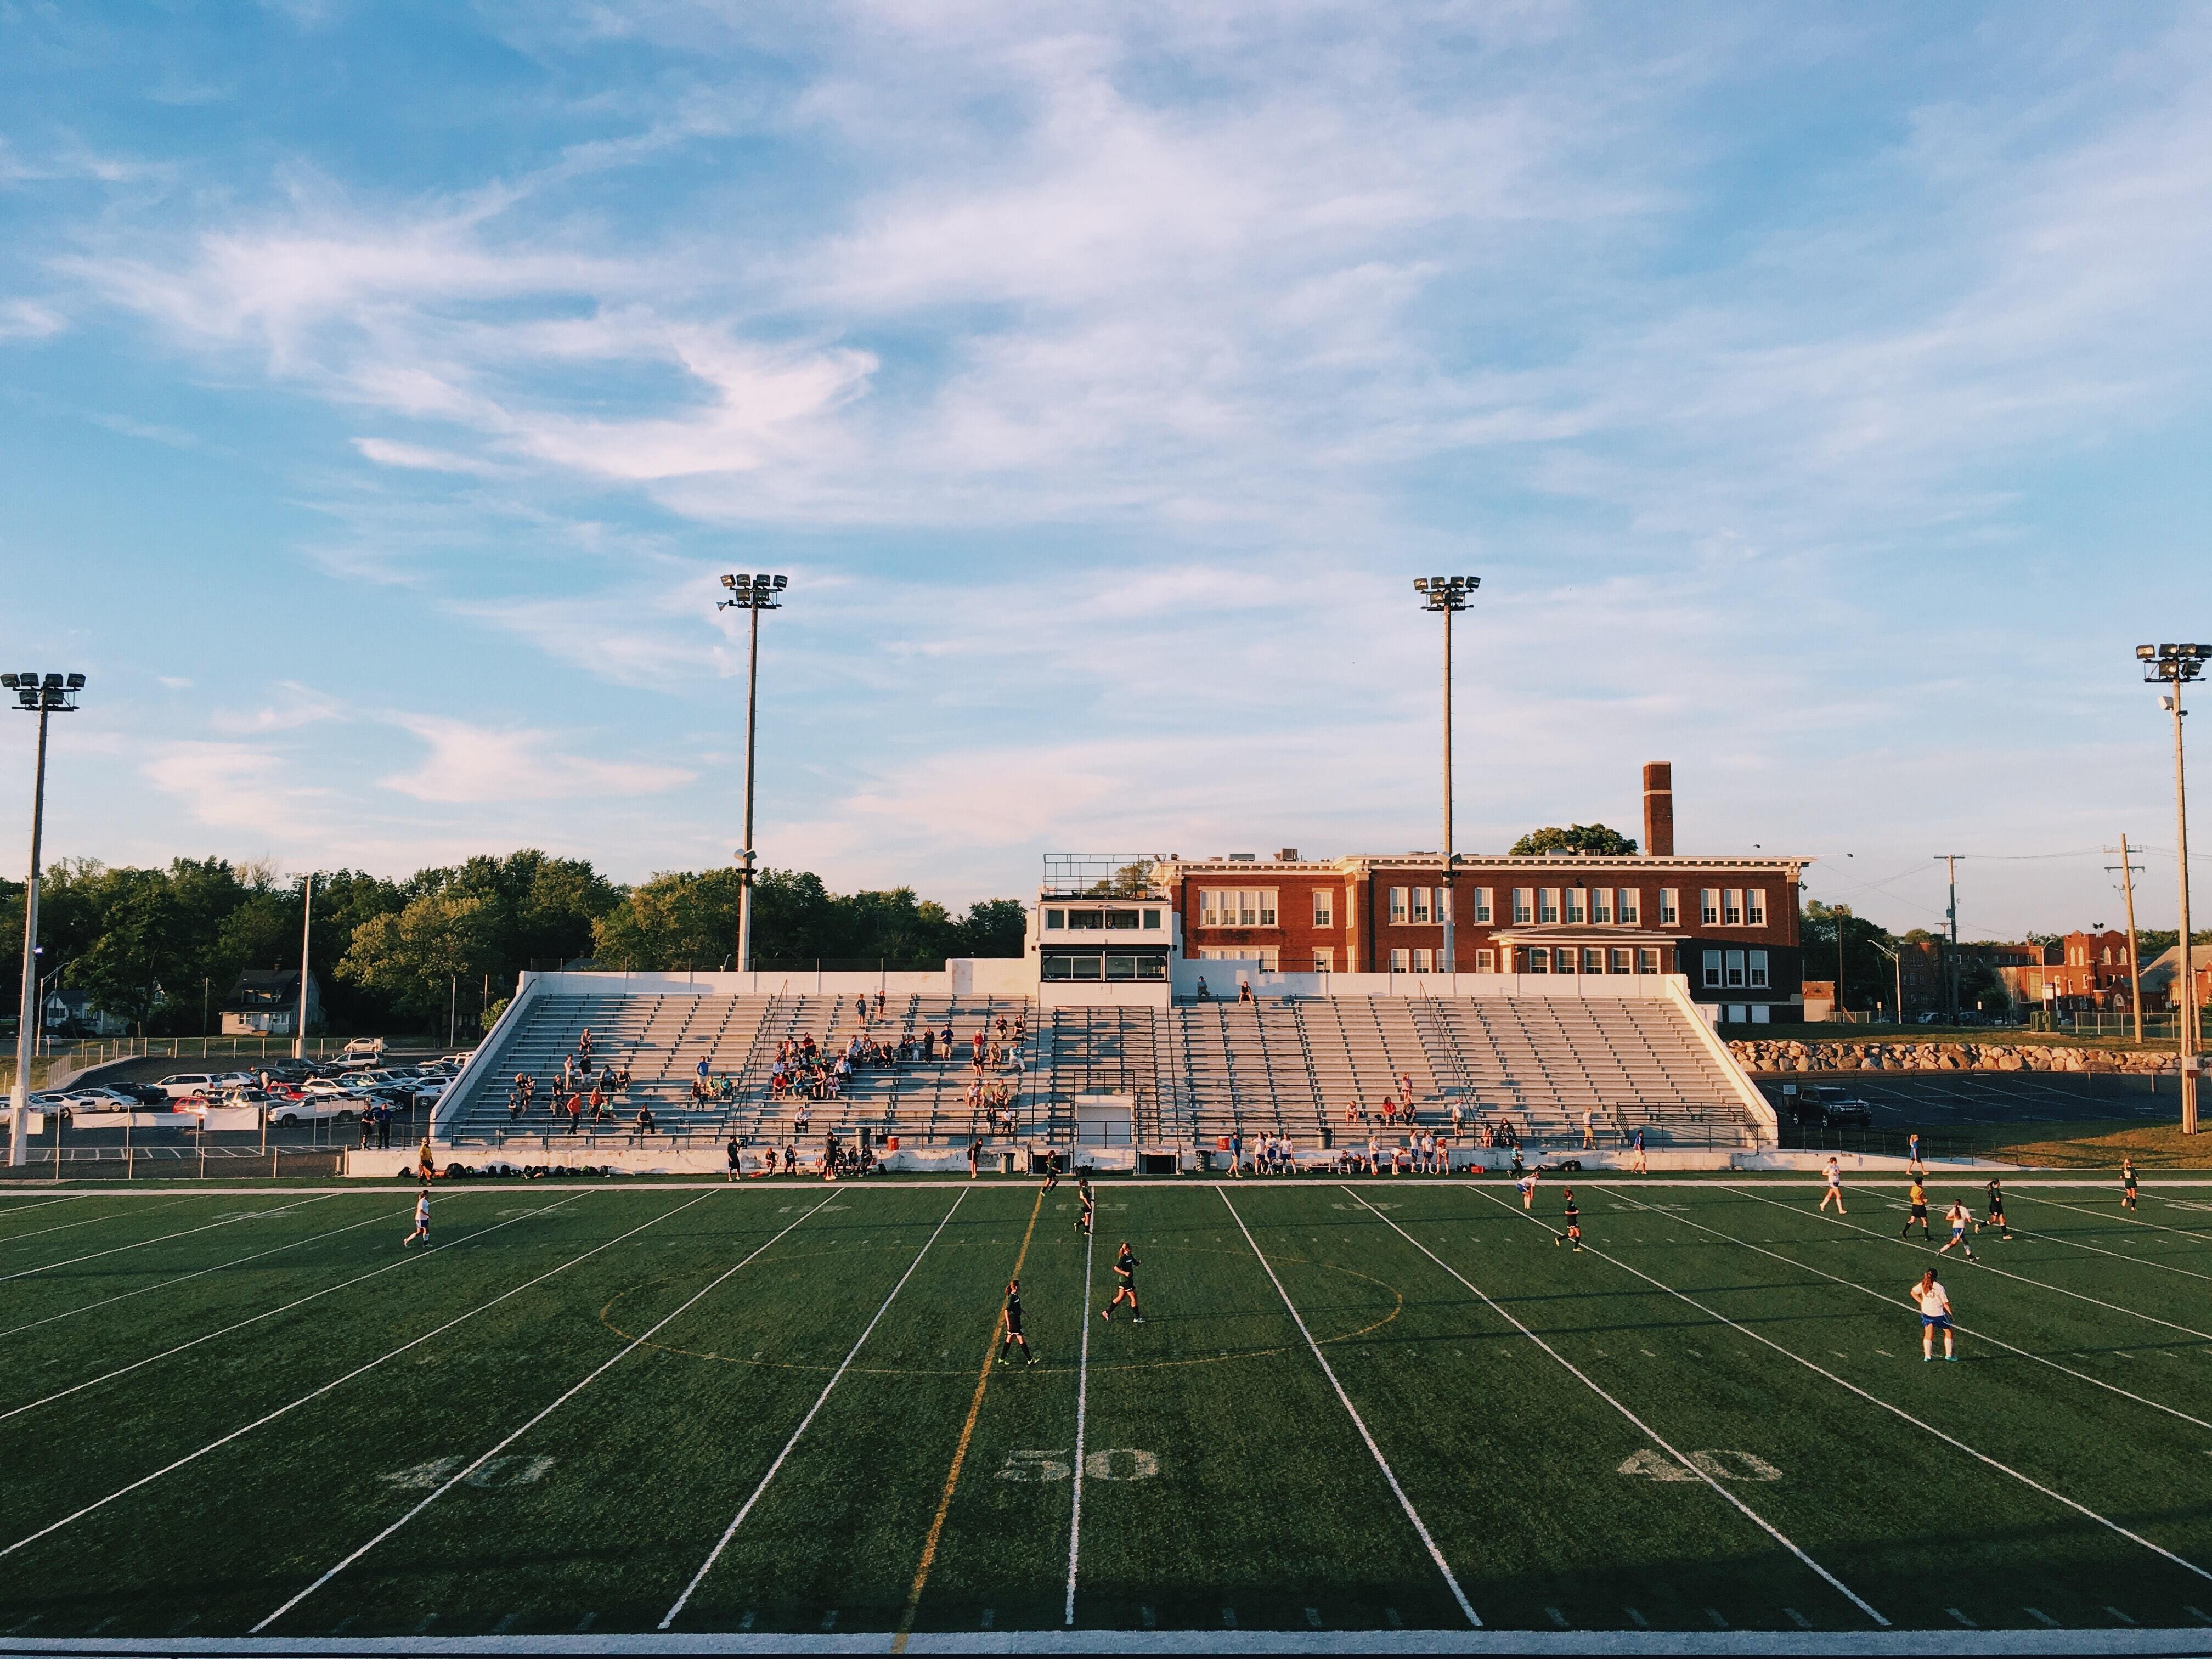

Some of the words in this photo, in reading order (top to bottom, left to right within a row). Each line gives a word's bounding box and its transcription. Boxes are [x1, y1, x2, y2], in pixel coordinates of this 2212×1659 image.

[377, 1454, 556, 1489] 40
[994, 1448, 1159, 1482] 50
[1616, 1448, 1783, 1482] 40
